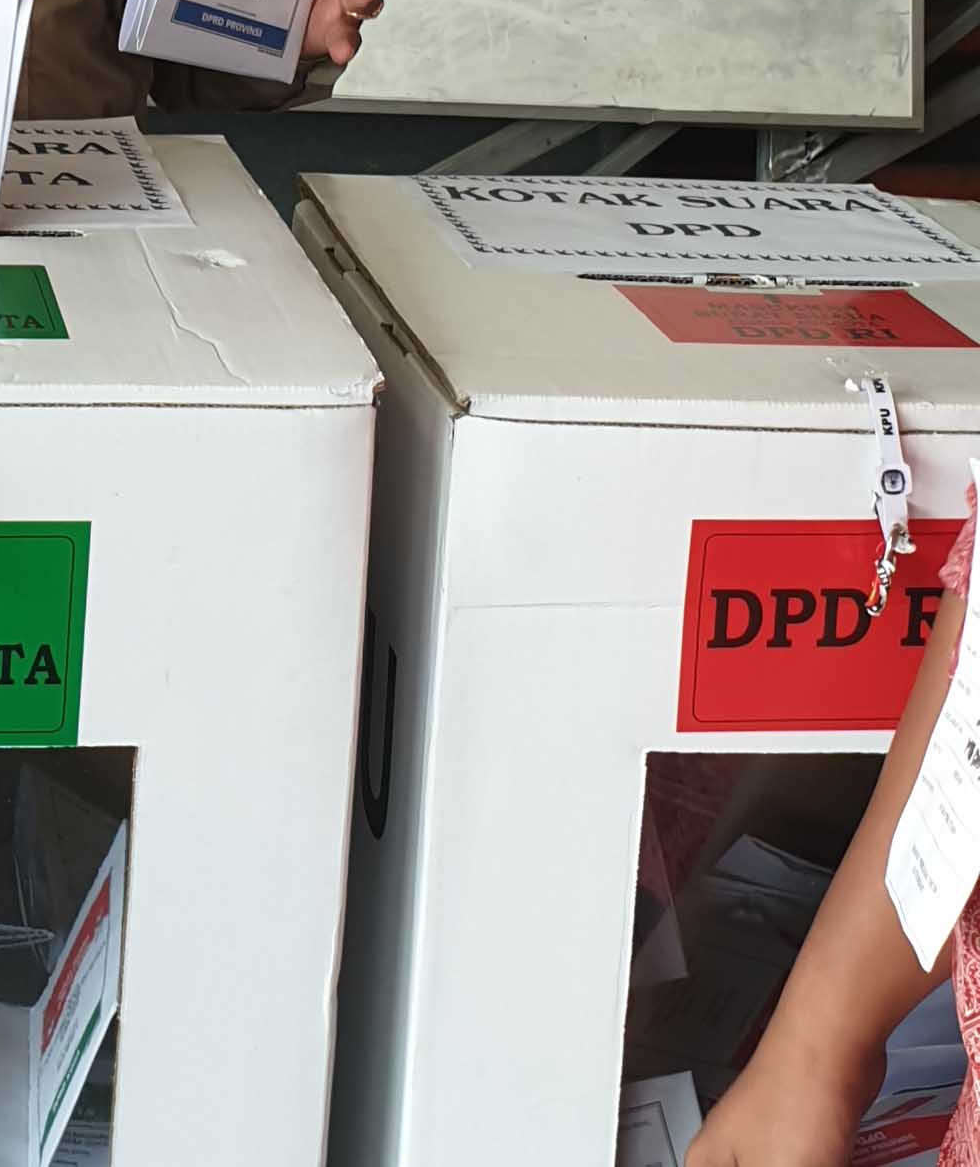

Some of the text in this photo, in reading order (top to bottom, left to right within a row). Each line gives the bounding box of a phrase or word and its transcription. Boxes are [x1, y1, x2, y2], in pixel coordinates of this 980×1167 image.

[7, 142, 118, 155] ARA
[443, 185, 882, 213] KOTAK SUARA
[627, 221, 762, 238] DPD
[879, 407, 893, 436] KPU
[706, 587, 873, 650] DPD
